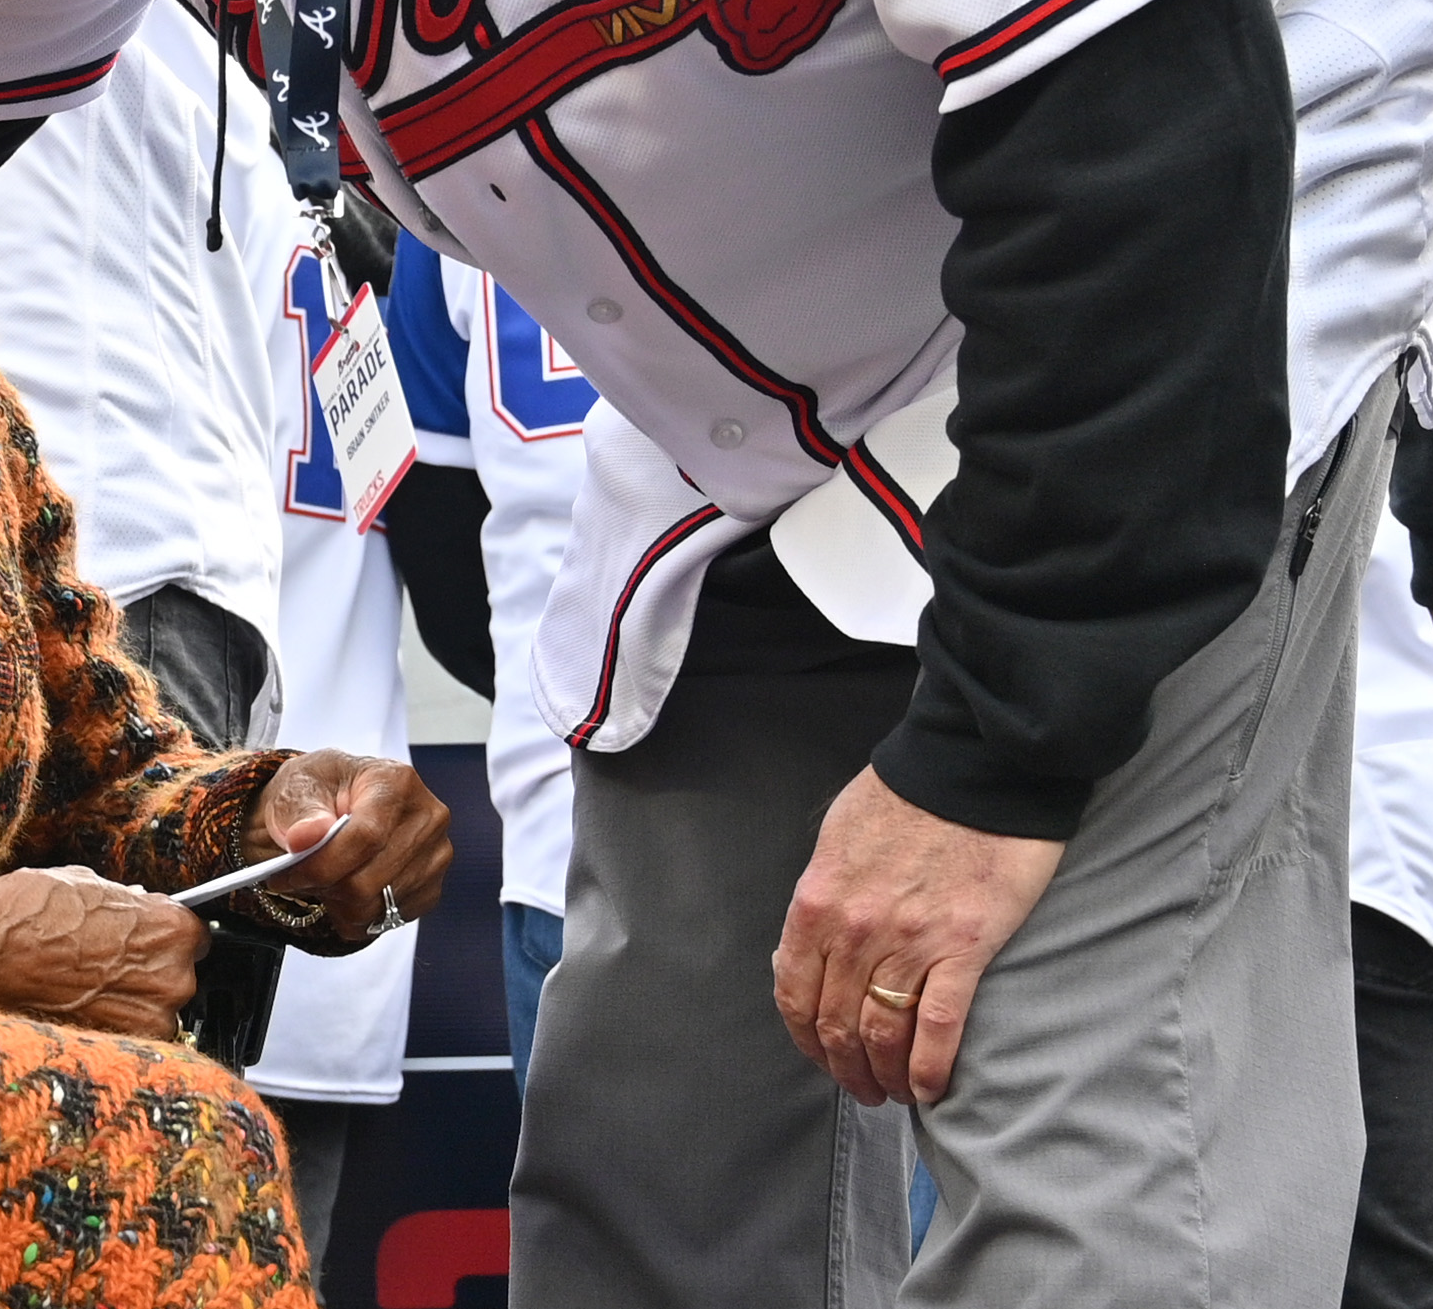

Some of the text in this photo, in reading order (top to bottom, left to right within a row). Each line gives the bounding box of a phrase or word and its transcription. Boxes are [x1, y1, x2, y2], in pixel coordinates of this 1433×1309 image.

[329, 338, 387, 436] PARADE
[365, 389, 391, 437] SNITKER
[353, 469, 386, 523] TRUCKS
